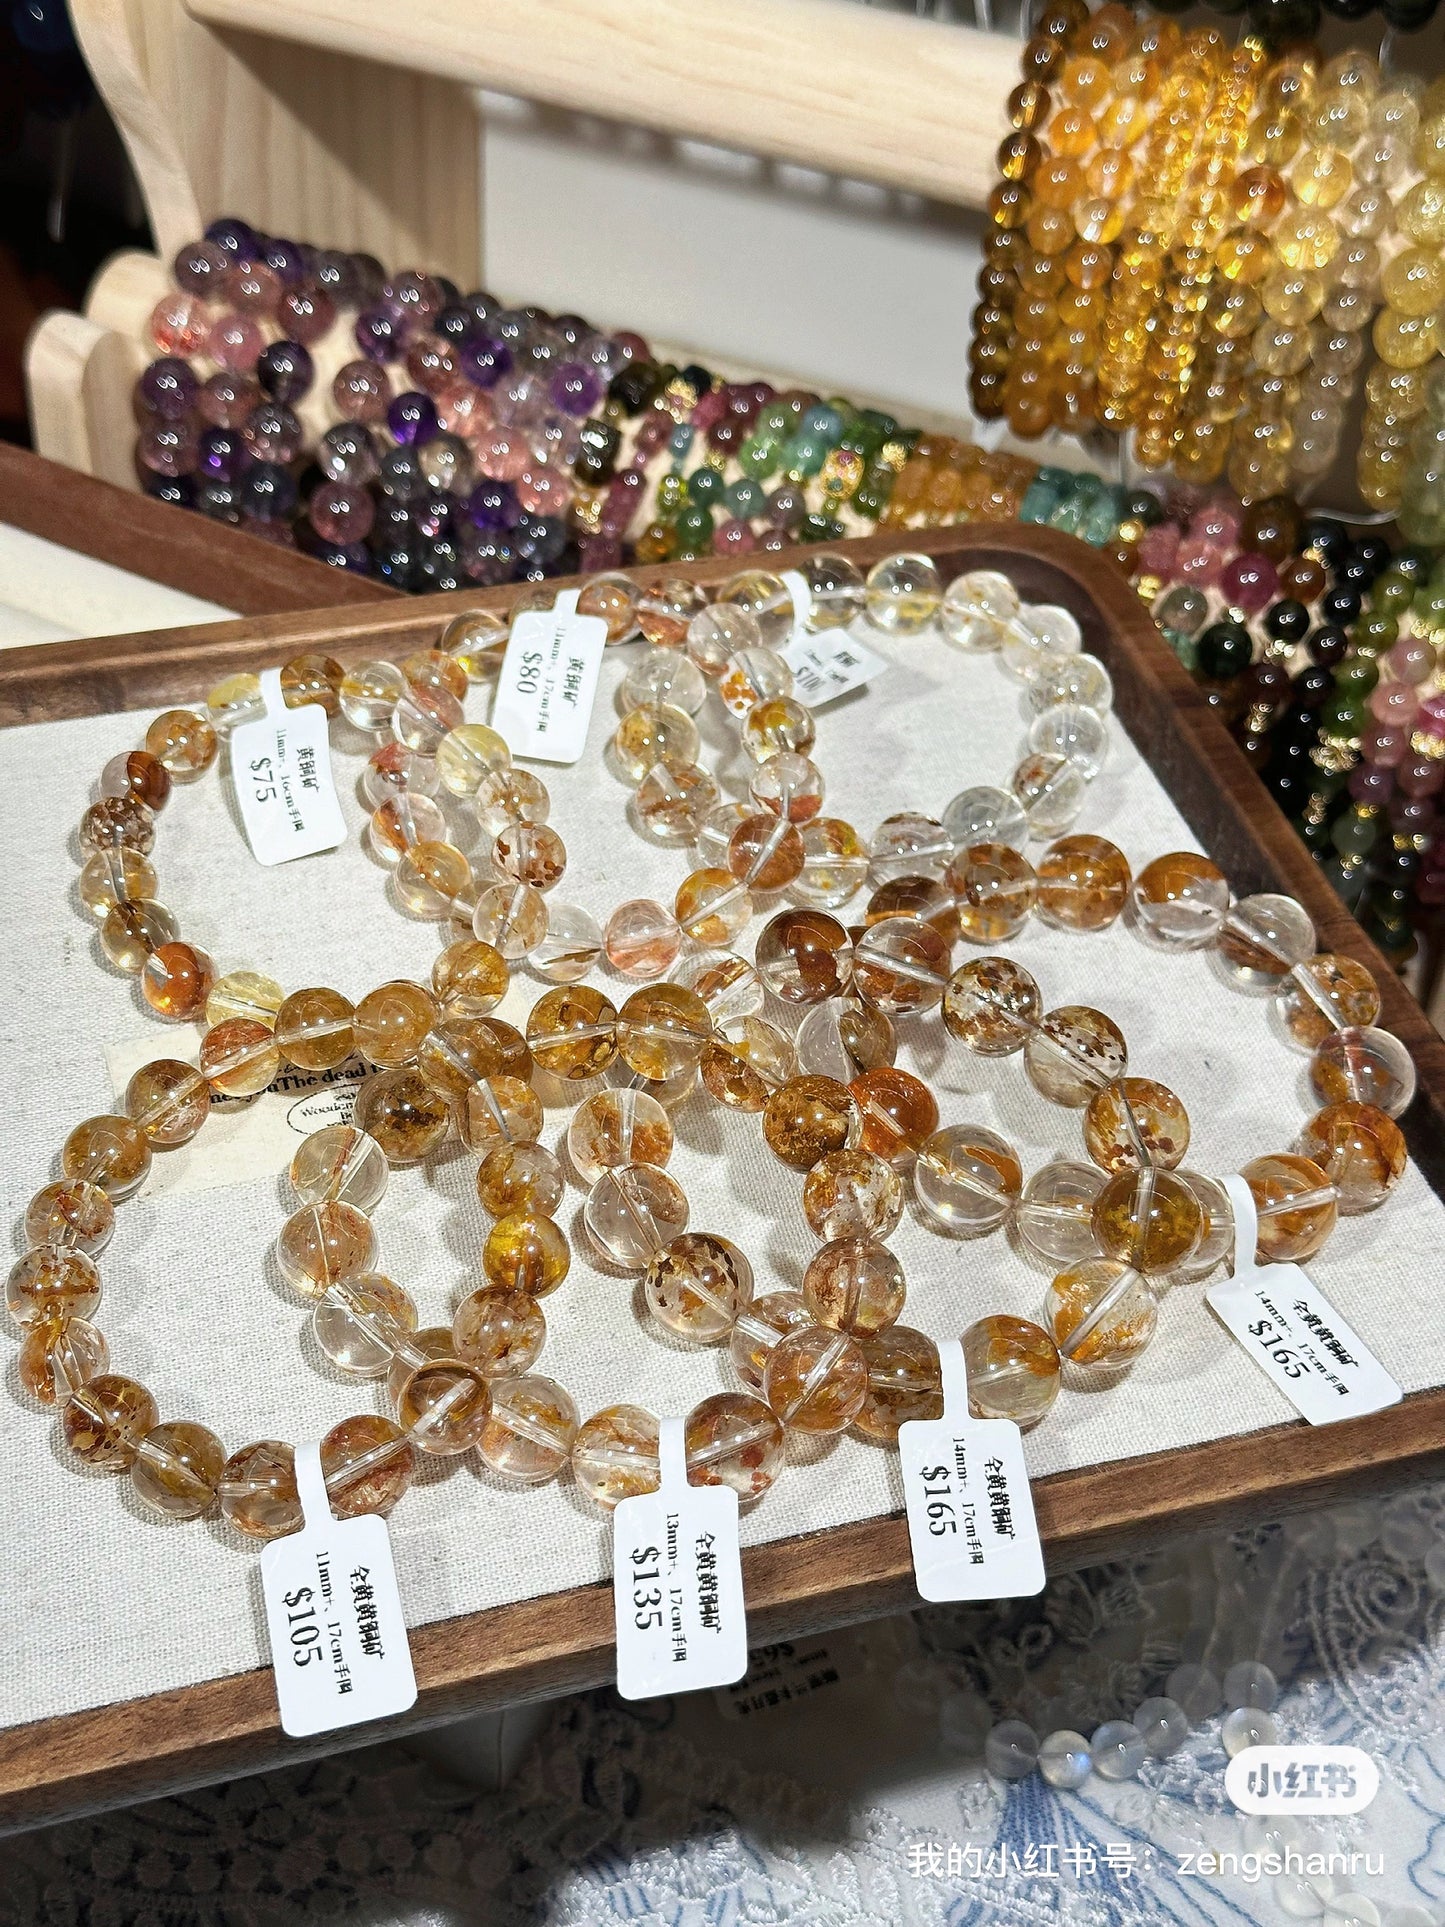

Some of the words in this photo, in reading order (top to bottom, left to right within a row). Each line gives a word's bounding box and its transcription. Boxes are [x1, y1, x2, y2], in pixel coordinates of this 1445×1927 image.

[517, 651, 543, 694] $80
[249, 757, 277, 803] $75
[322, 1062, 367, 1082] dead
[1247, 1319, 1312, 1379] $165
[919, 1465, 957, 1536] $165
[628, 1546, 663, 1631] $135
[281, 1586, 323, 1667] $105
